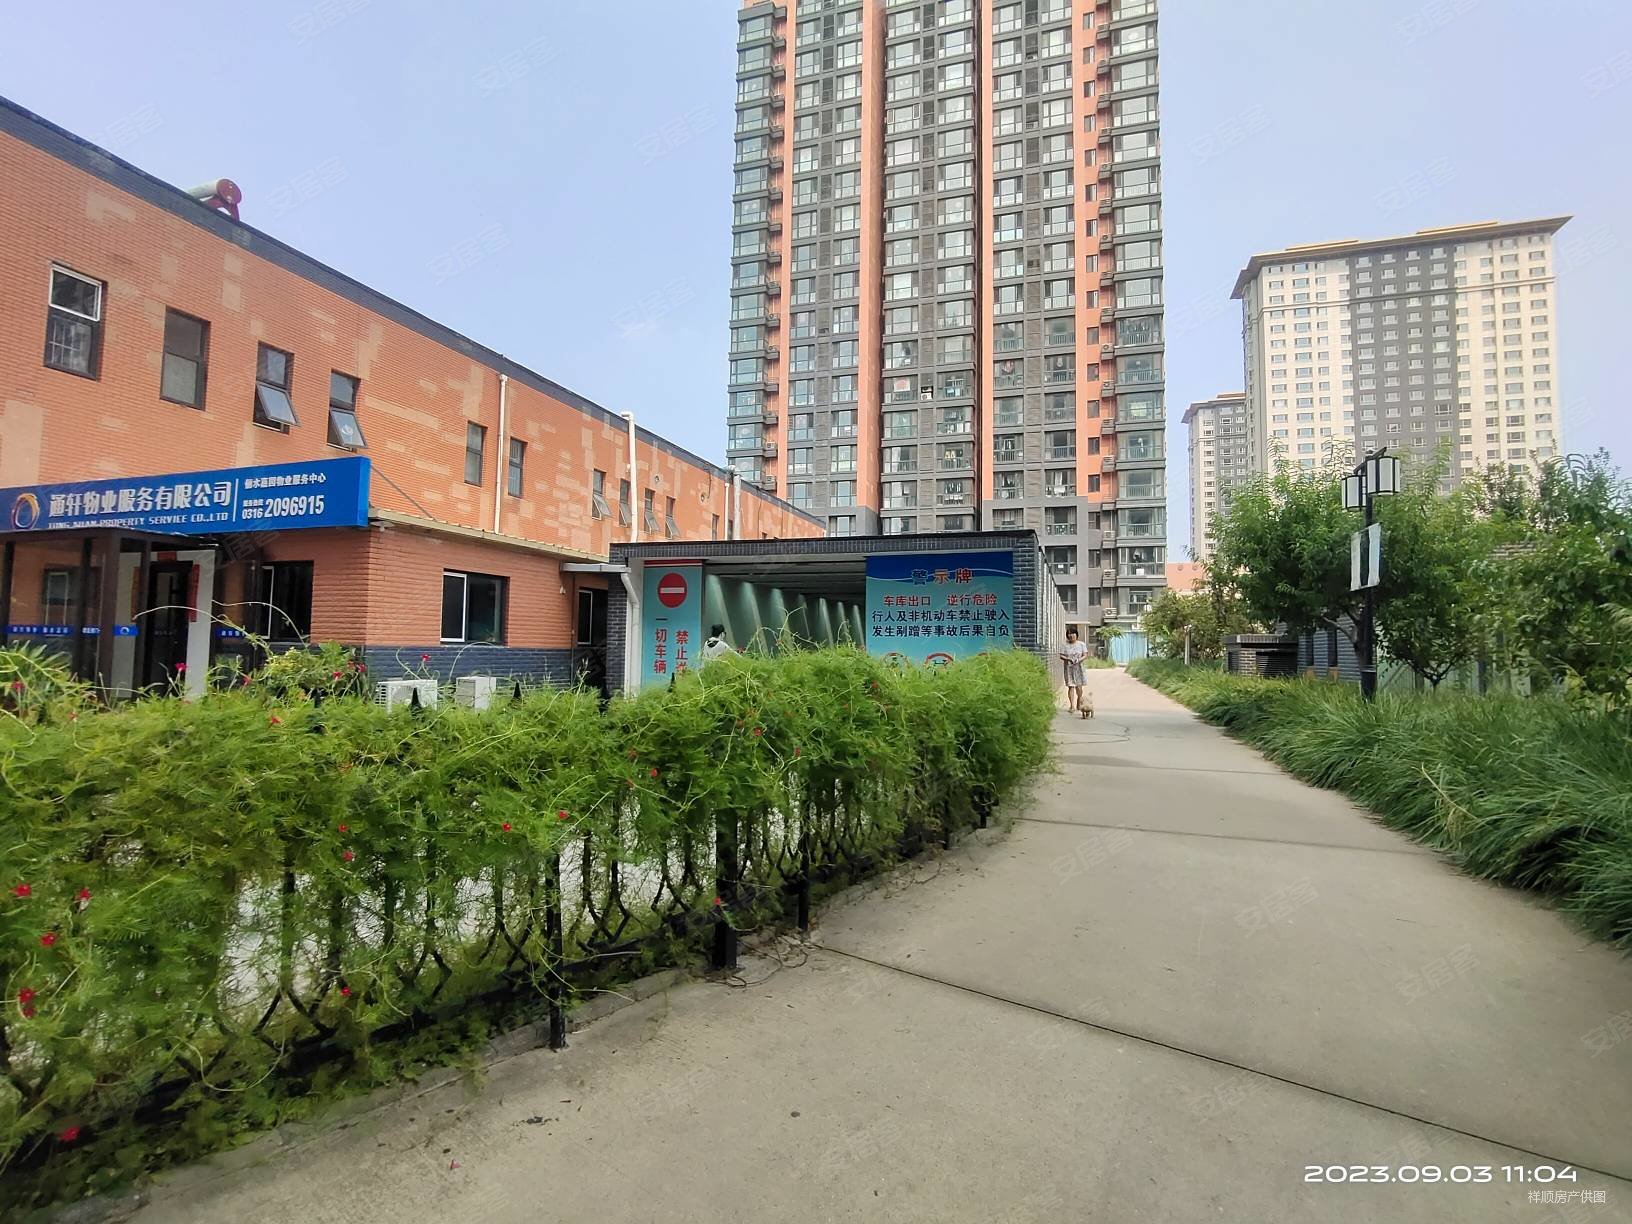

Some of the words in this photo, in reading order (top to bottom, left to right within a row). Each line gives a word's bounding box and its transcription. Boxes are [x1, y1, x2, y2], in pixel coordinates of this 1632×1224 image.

[49, 481, 232, 518] 通轩物业服务有限公司
[242, 509, 263, 520] 0316
[264, 495, 325, 518] 2096915
[148, 515, 187, 525] SERVICE
[912, 568, 973, 585] 警示牌
[883, 596, 931, 607] 车库出口
[947, 593, 998, 606] 逆行危险
[872, 609, 1010, 622] 行人及非机动车禁止驶入
[872, 625, 1010, 638] 发生剐蹭等事故后果自负
[654, 618, 668, 674] 一切车辆
